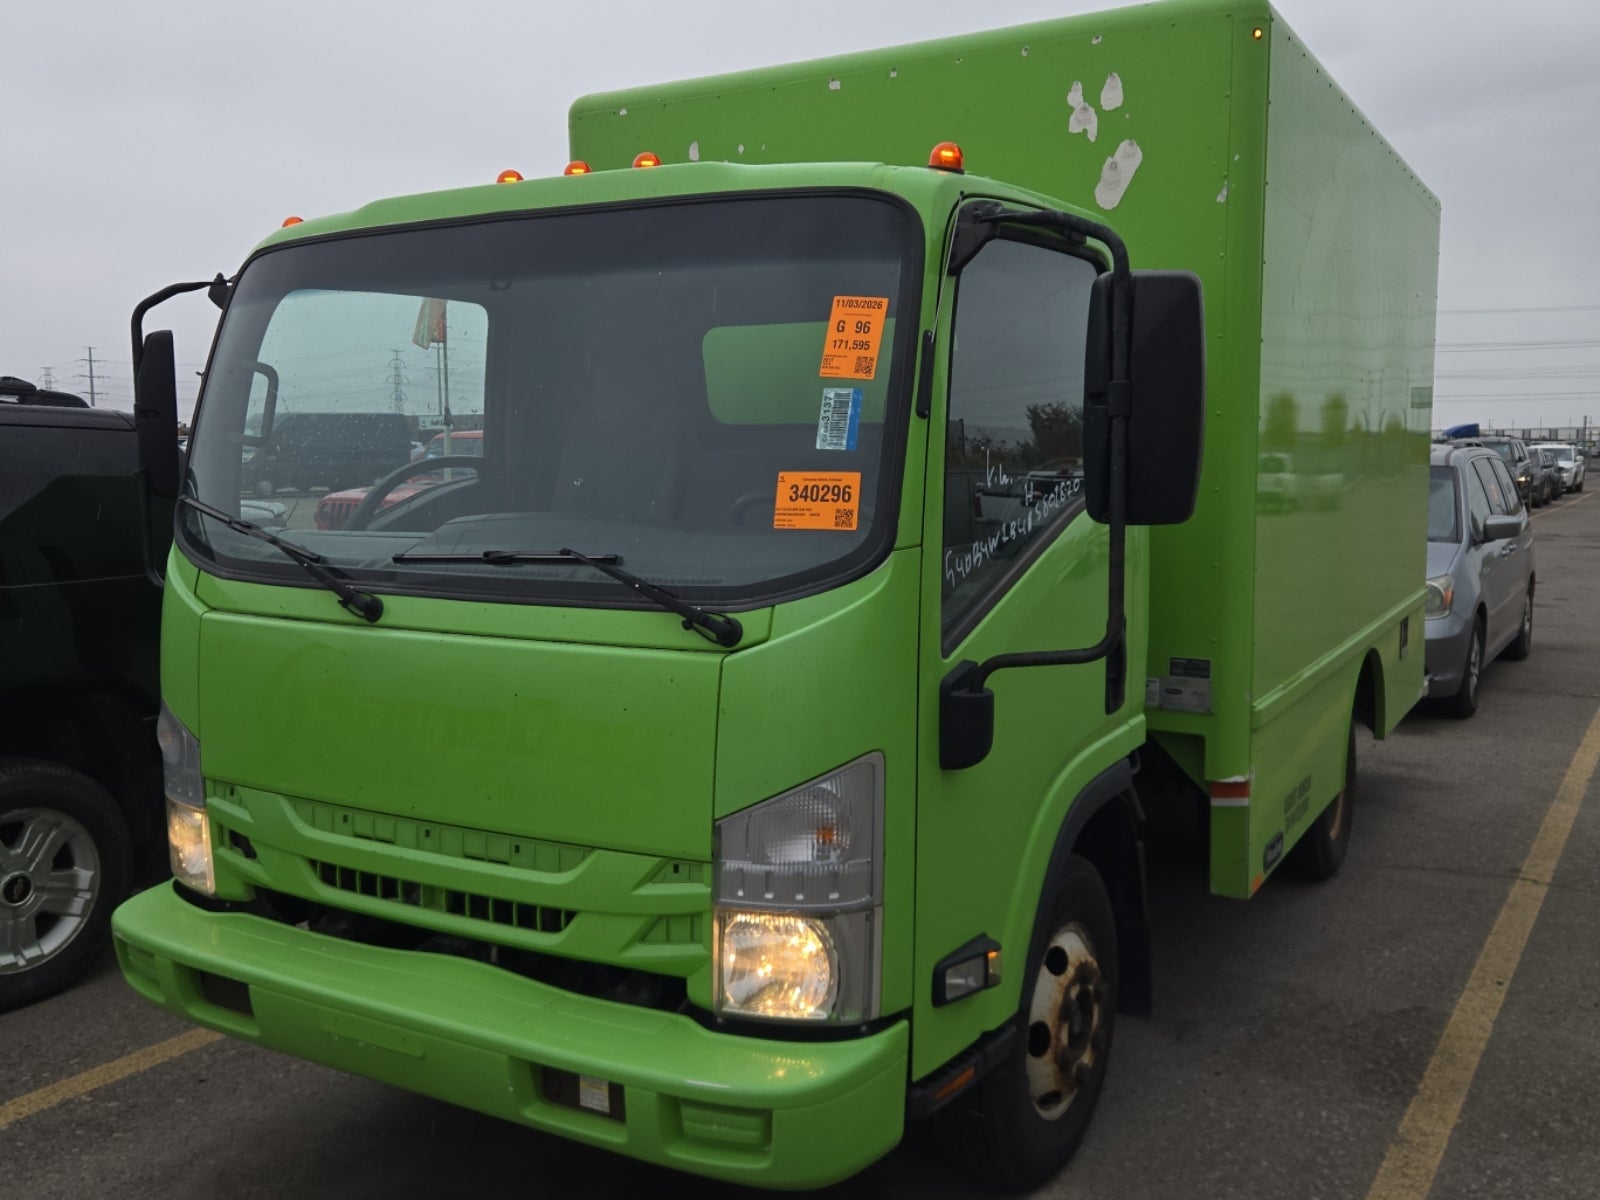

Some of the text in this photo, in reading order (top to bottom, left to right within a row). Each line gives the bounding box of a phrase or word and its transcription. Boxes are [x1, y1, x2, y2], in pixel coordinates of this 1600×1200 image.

[836, 299, 883, 309] 11/03/2026
[836, 320, 871, 334] G 96
[833, 339, 870, 351] 171,595
[789, 484, 852, 503] 340296
